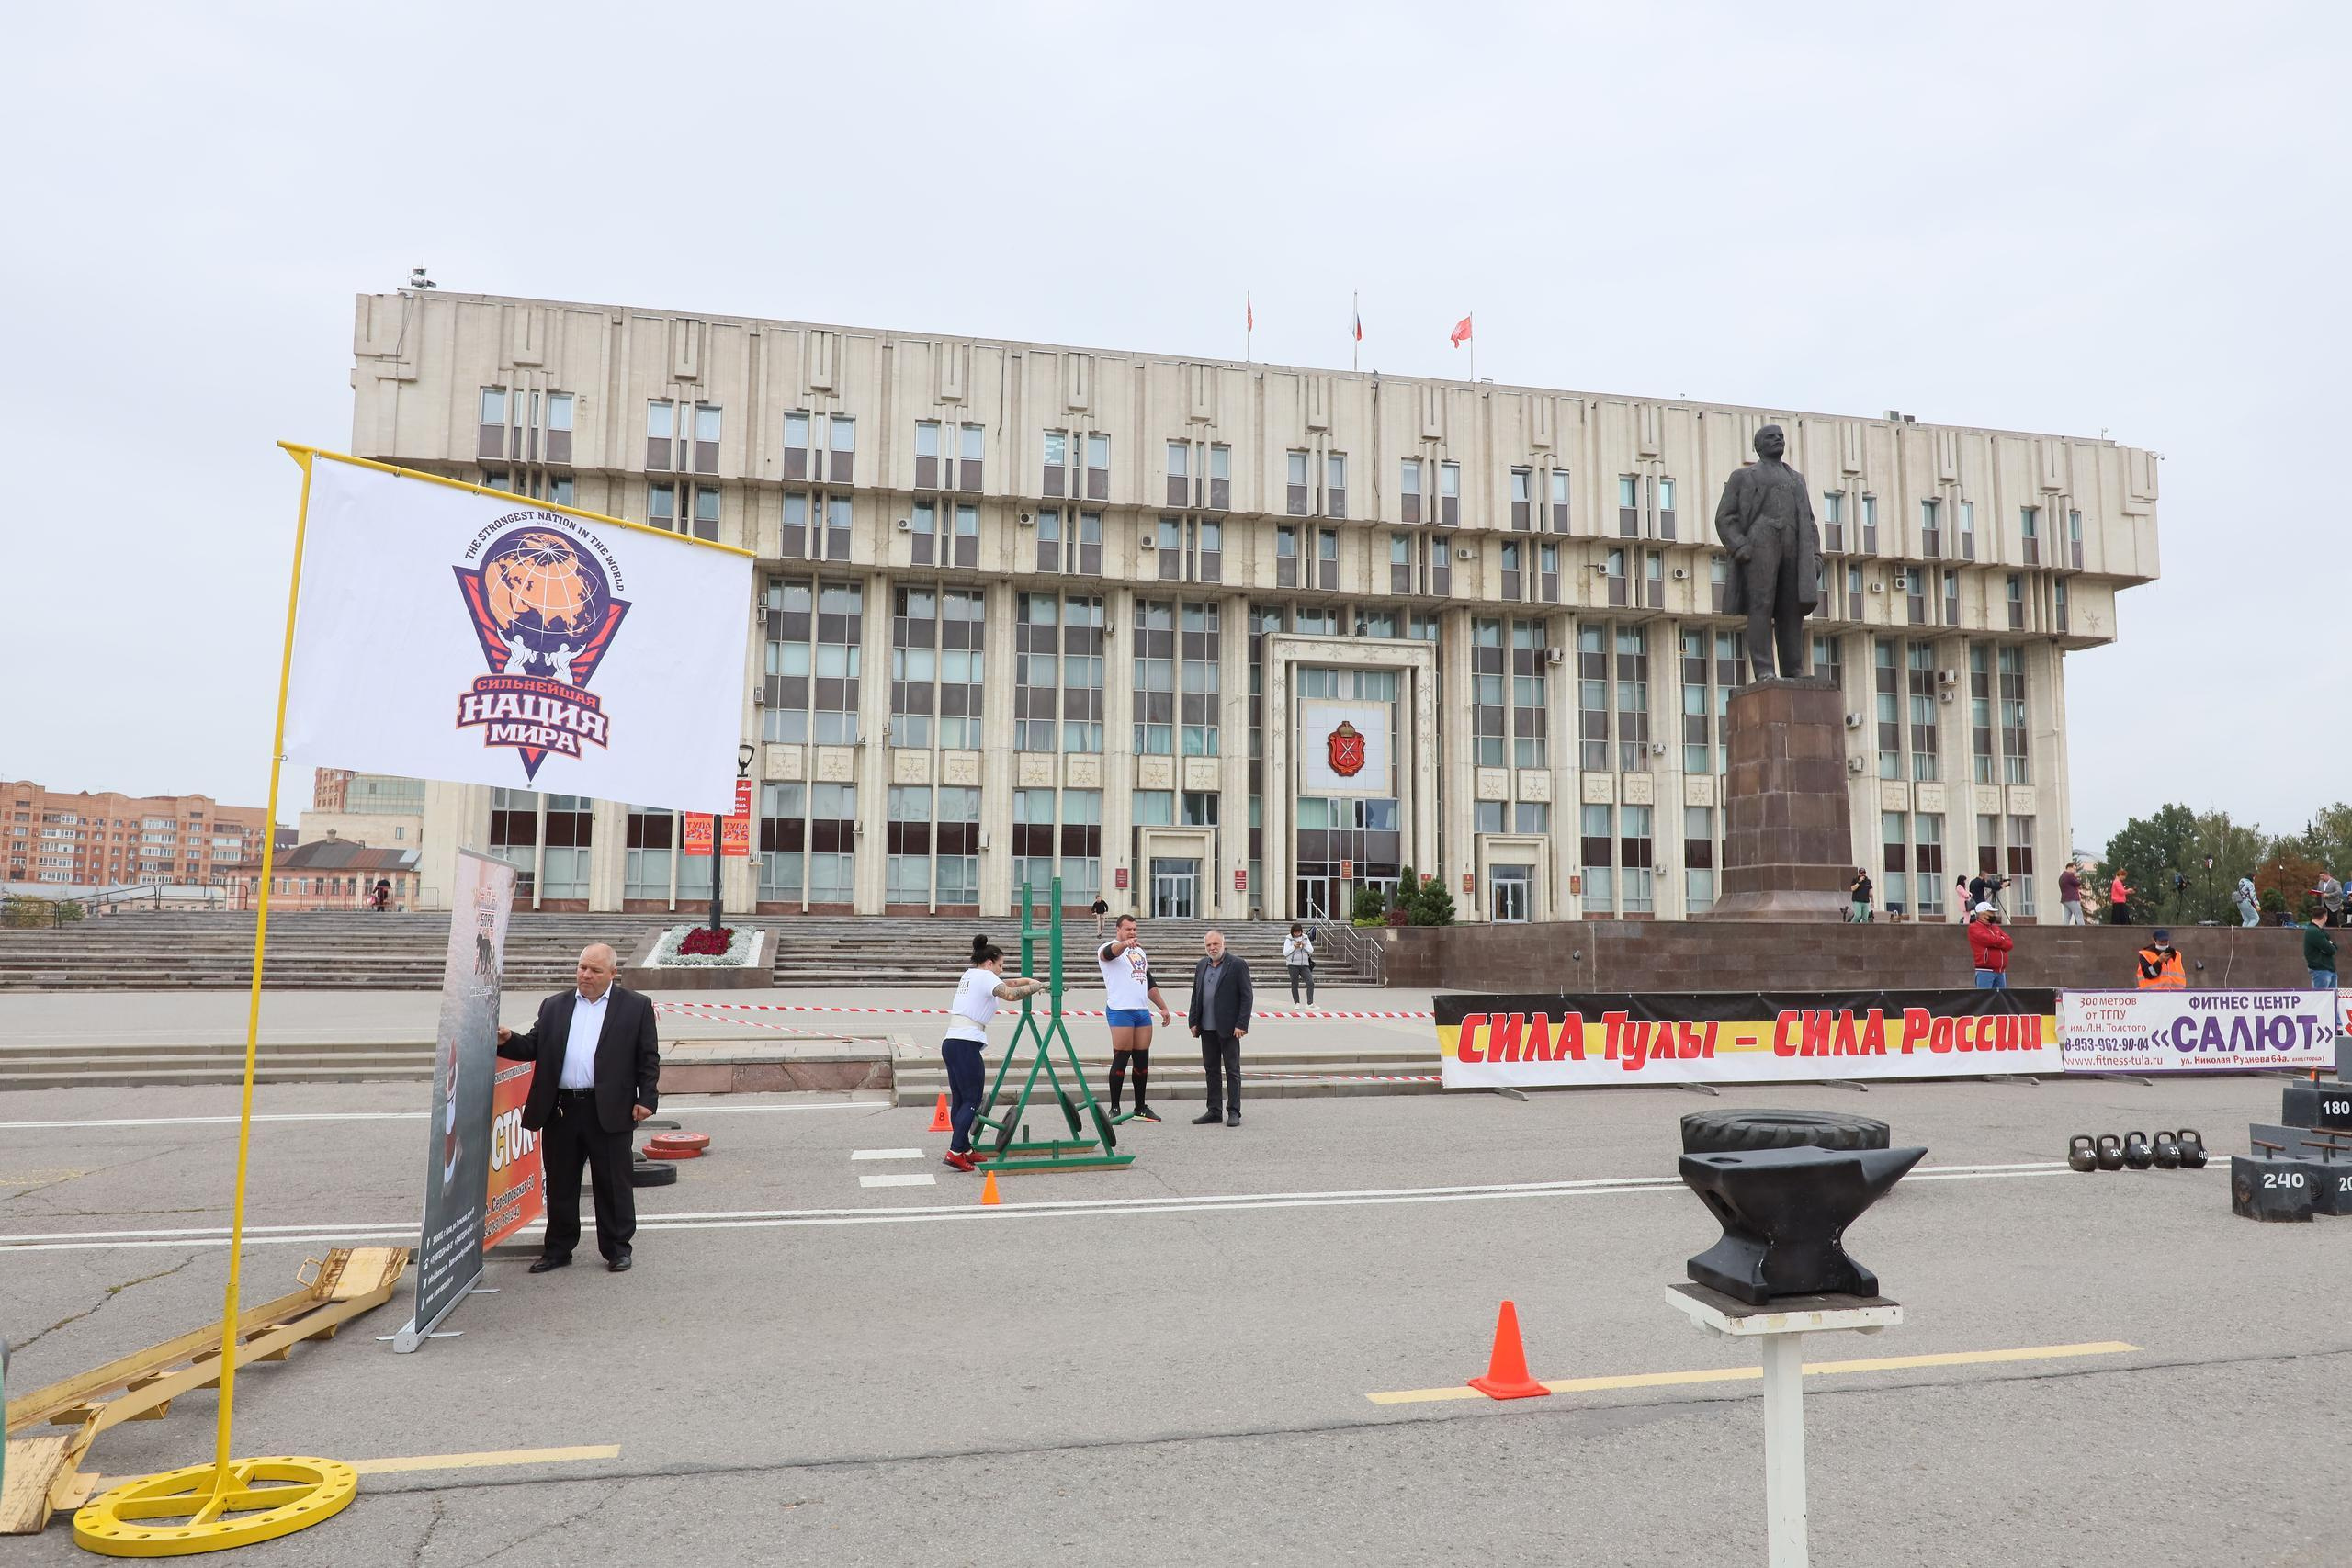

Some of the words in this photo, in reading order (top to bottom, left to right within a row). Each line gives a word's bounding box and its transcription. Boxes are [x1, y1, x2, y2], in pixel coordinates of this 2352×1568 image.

[465, 539, 481, 560] THE
[477, 512, 535, 541] STRONGEST
[537, 512, 577, 532] NATION
[578, 527, 591, 539] IN
[590, 536, 609, 556] THE
[605, 556, 625, 592] WORLD
[476, 678, 597, 709] СИЛЬНЕЙШАЯ
[461, 694, 606, 743] НАЦИЯ
[490, 723, 578, 753] МИРА
[2080, 997, 2098, 1008] 300
[2099, 998, 2138, 1009] метров
[2188, 996, 2249, 1010] ФИТНЕС
[2253, 995, 2301, 1011] ЦЕНТР
[2086, 1011, 2098, 1021] от
[2099, 1010, 2127, 1021] ТГПУ
[2070, 1024, 2085, 1033] им.
[2086, 1023, 2105, 1033] Л.Н.
[2107, 1023, 2147, 1033] Толстого
[2151, 1014, 2334, 1054] «САЛЮТ»
[1457, 1011, 1587, 1064] СИЛА
[1600, 1010, 1720, 1071] Тулы
[1773, 1008, 1888, 1057] СИЛА
[1901, 1007, 2043, 1055] России
[2064, 1037, 2150, 1052] 8-953-962-90-04
[2064, 1055, 2164, 1066] www.fitness-tula.ru
[2180, 1057, 2193, 1066] ул.
[2194, 1055, 2232, 1066] Николая
[2233, 1055, 2270, 1066] Руднева
[2323, 1100, 2350, 1115] 180
[938, 1111, 945, 1122] 8
[2084, 1150, 2097, 1158] 24
[2110, 1149, 2122, 1157] 24
[2140, 1145, 2152, 1155] 32
[2168, 1146, 2181, 1155] 32
[2198, 1150, 2209, 1160] 40
[2263, 1172, 2305, 1189] 240
